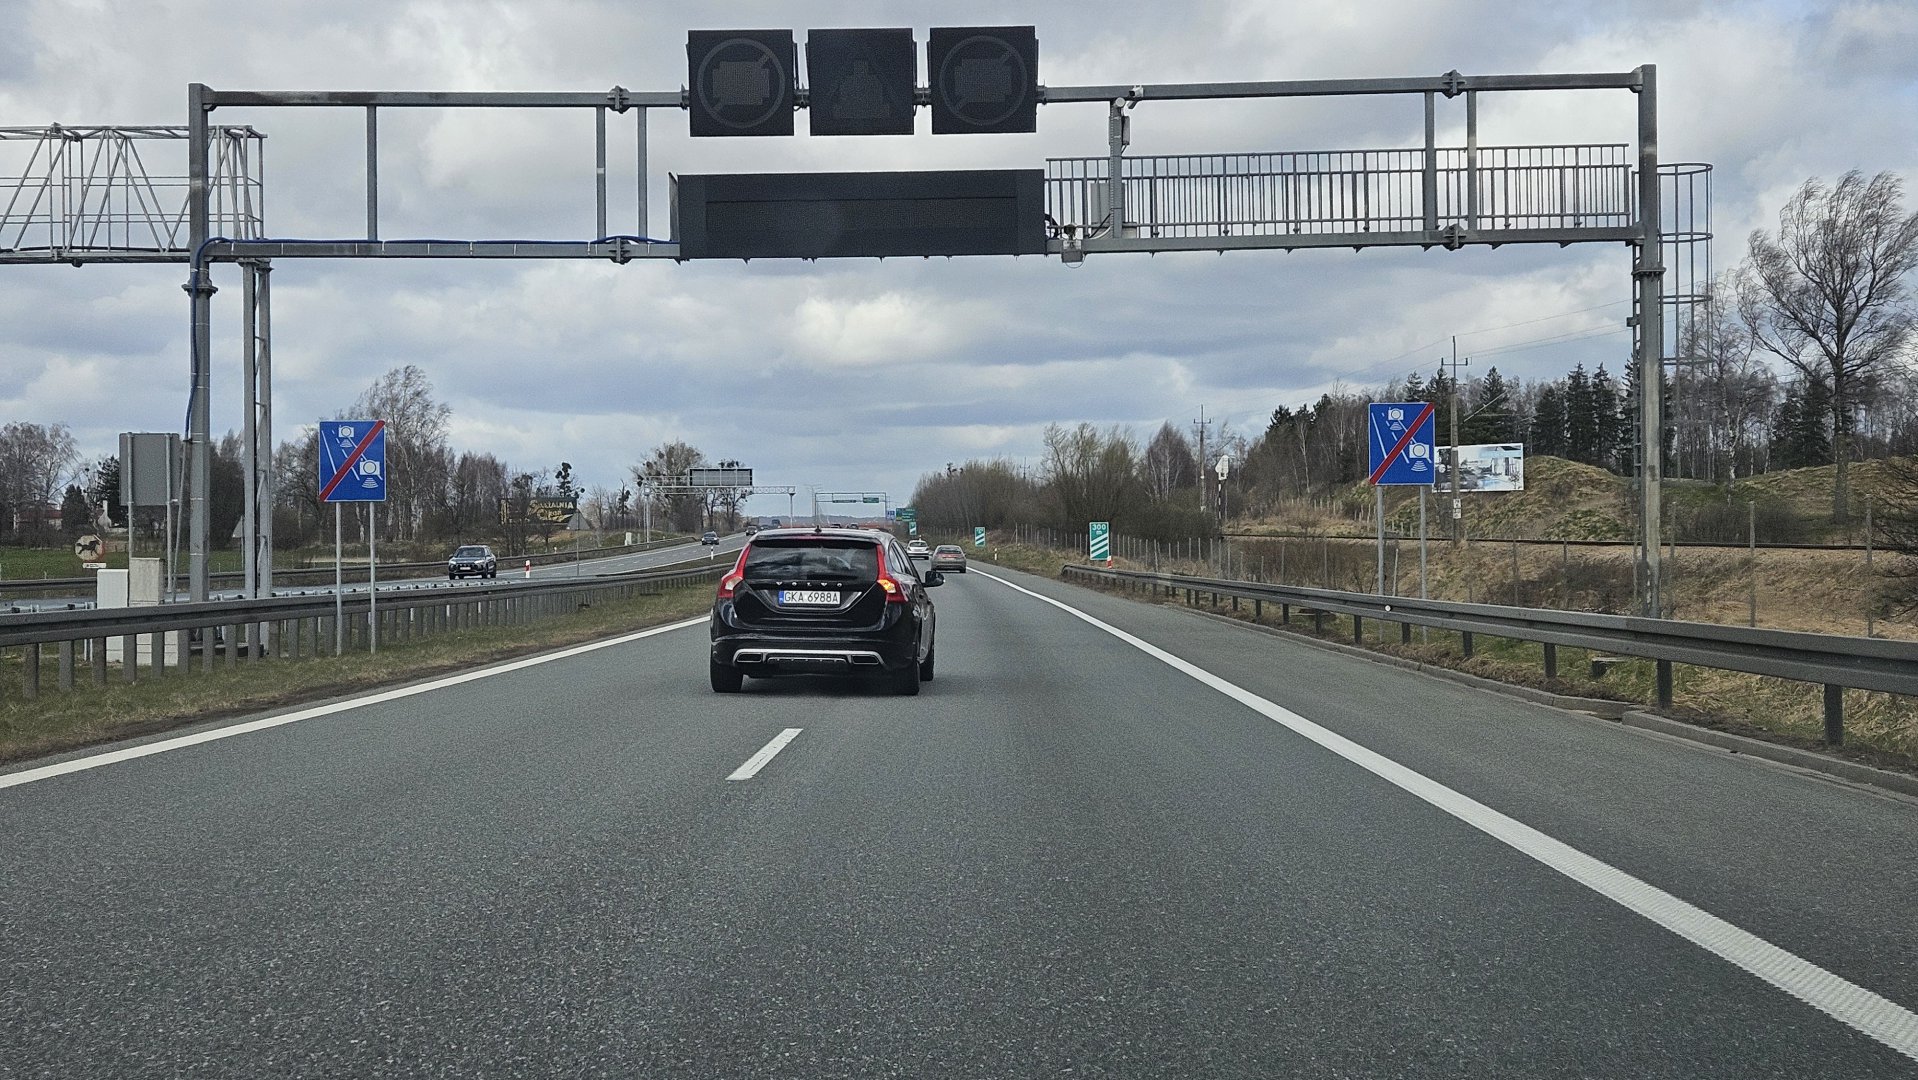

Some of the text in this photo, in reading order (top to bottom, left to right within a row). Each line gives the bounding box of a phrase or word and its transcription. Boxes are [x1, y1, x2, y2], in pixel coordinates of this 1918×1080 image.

[1092, 523, 1106, 531] 300
[784, 591, 804, 602] GKA
[807, 592, 839, 603] 6988A
